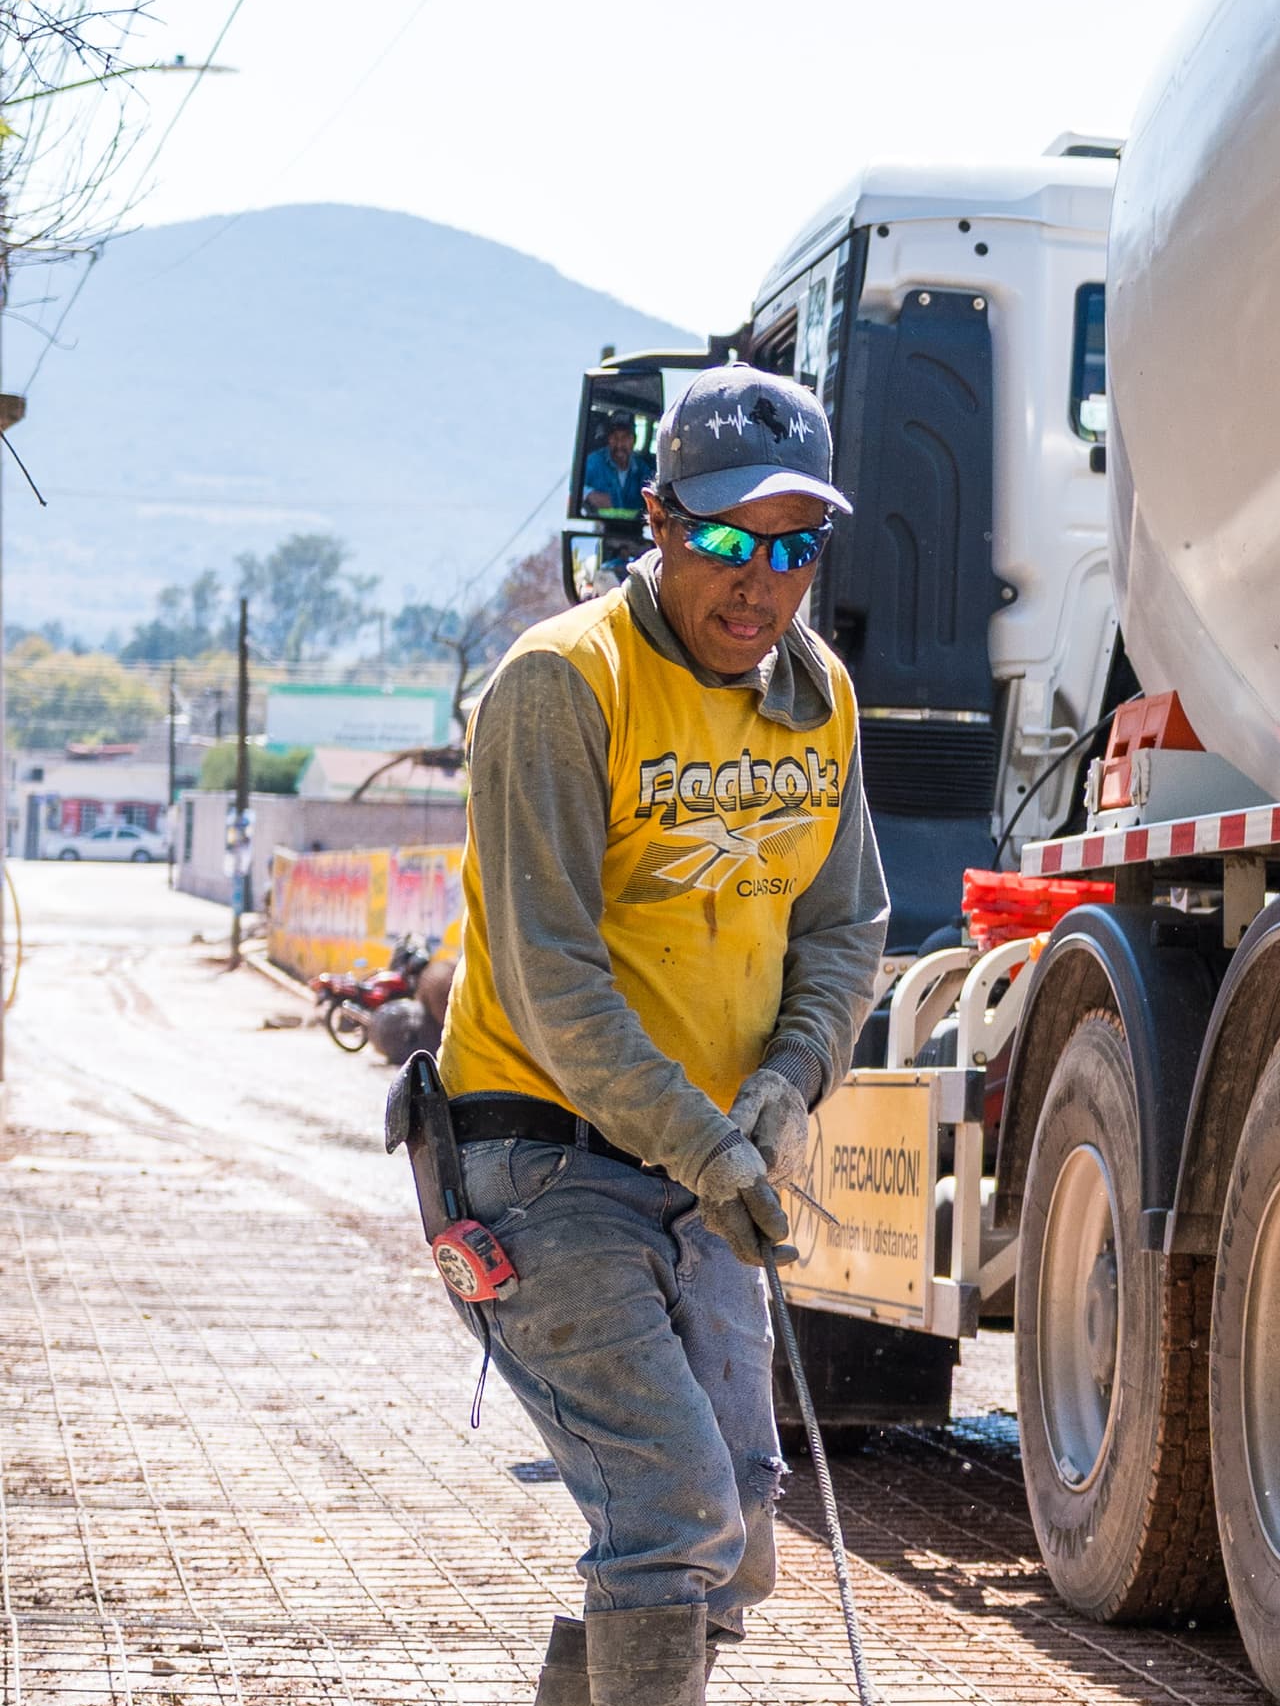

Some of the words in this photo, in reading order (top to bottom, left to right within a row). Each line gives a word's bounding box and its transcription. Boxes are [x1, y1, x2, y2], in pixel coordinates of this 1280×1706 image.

[635, 747, 840, 825] Reebok
[828, 1136, 920, 1199] ¡PRECAUCIÓN!
[862, 1220, 872, 1253] tu
[874, 1219, 919, 1260] distancia
